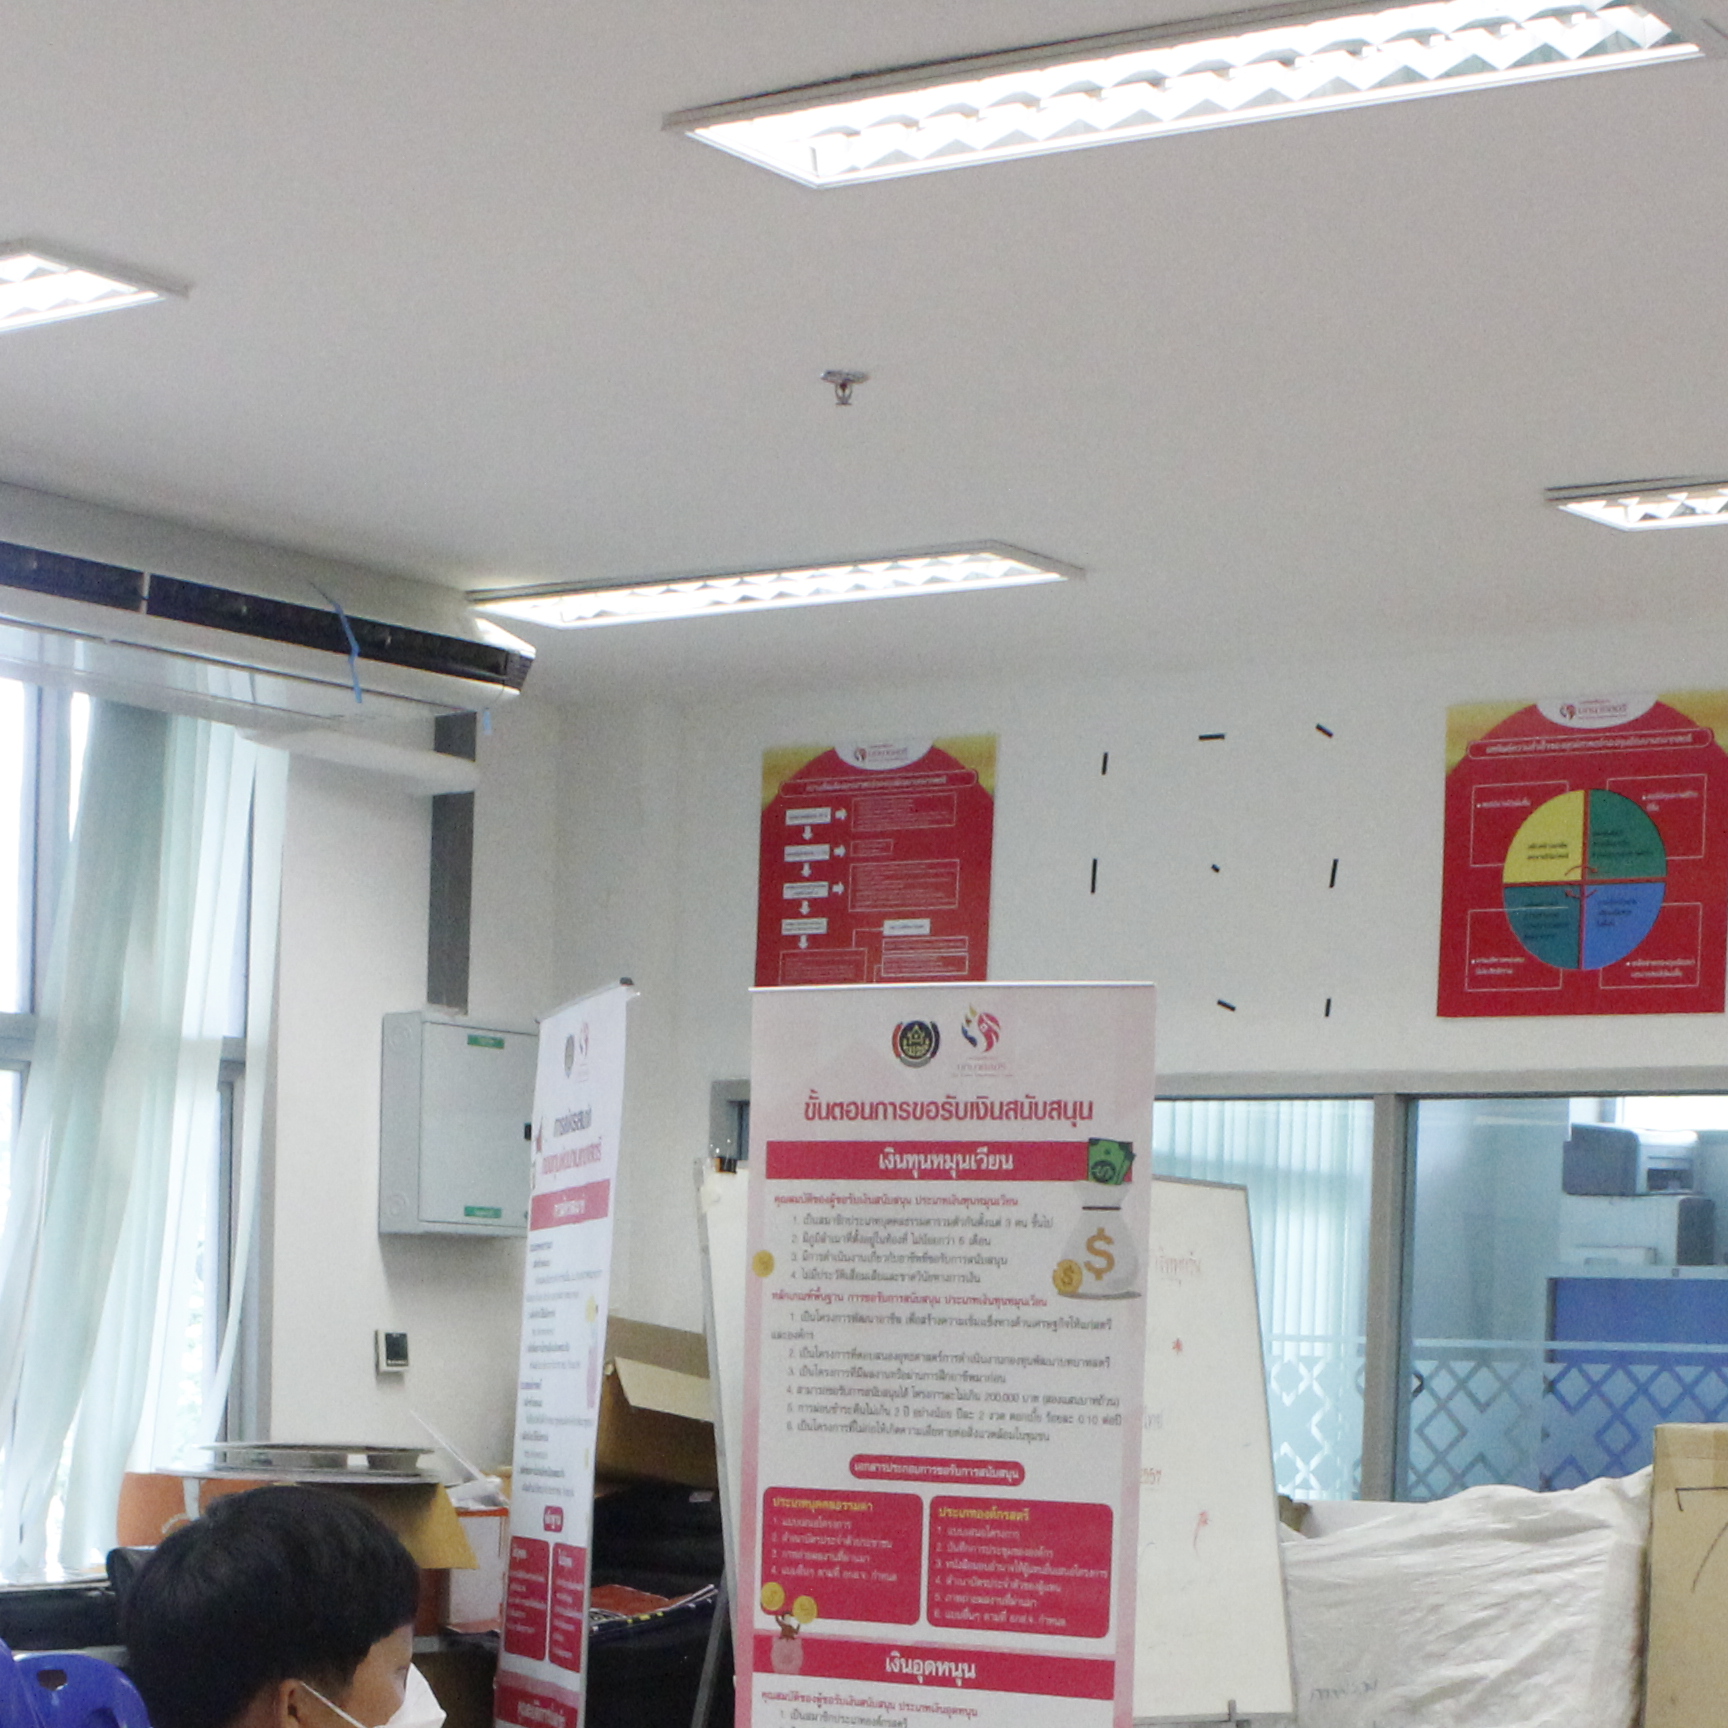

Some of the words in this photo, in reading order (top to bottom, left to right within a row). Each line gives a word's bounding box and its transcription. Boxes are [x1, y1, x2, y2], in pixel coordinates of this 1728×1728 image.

[804, 1090, 1093, 1127] ขั้นตอนการขอรับเงินสนับสนุน
[878, 1148, 1013, 1179] เงินทุนหมุนเวียน
[886, 1652, 976, 1686] เงินอุดหนุน
